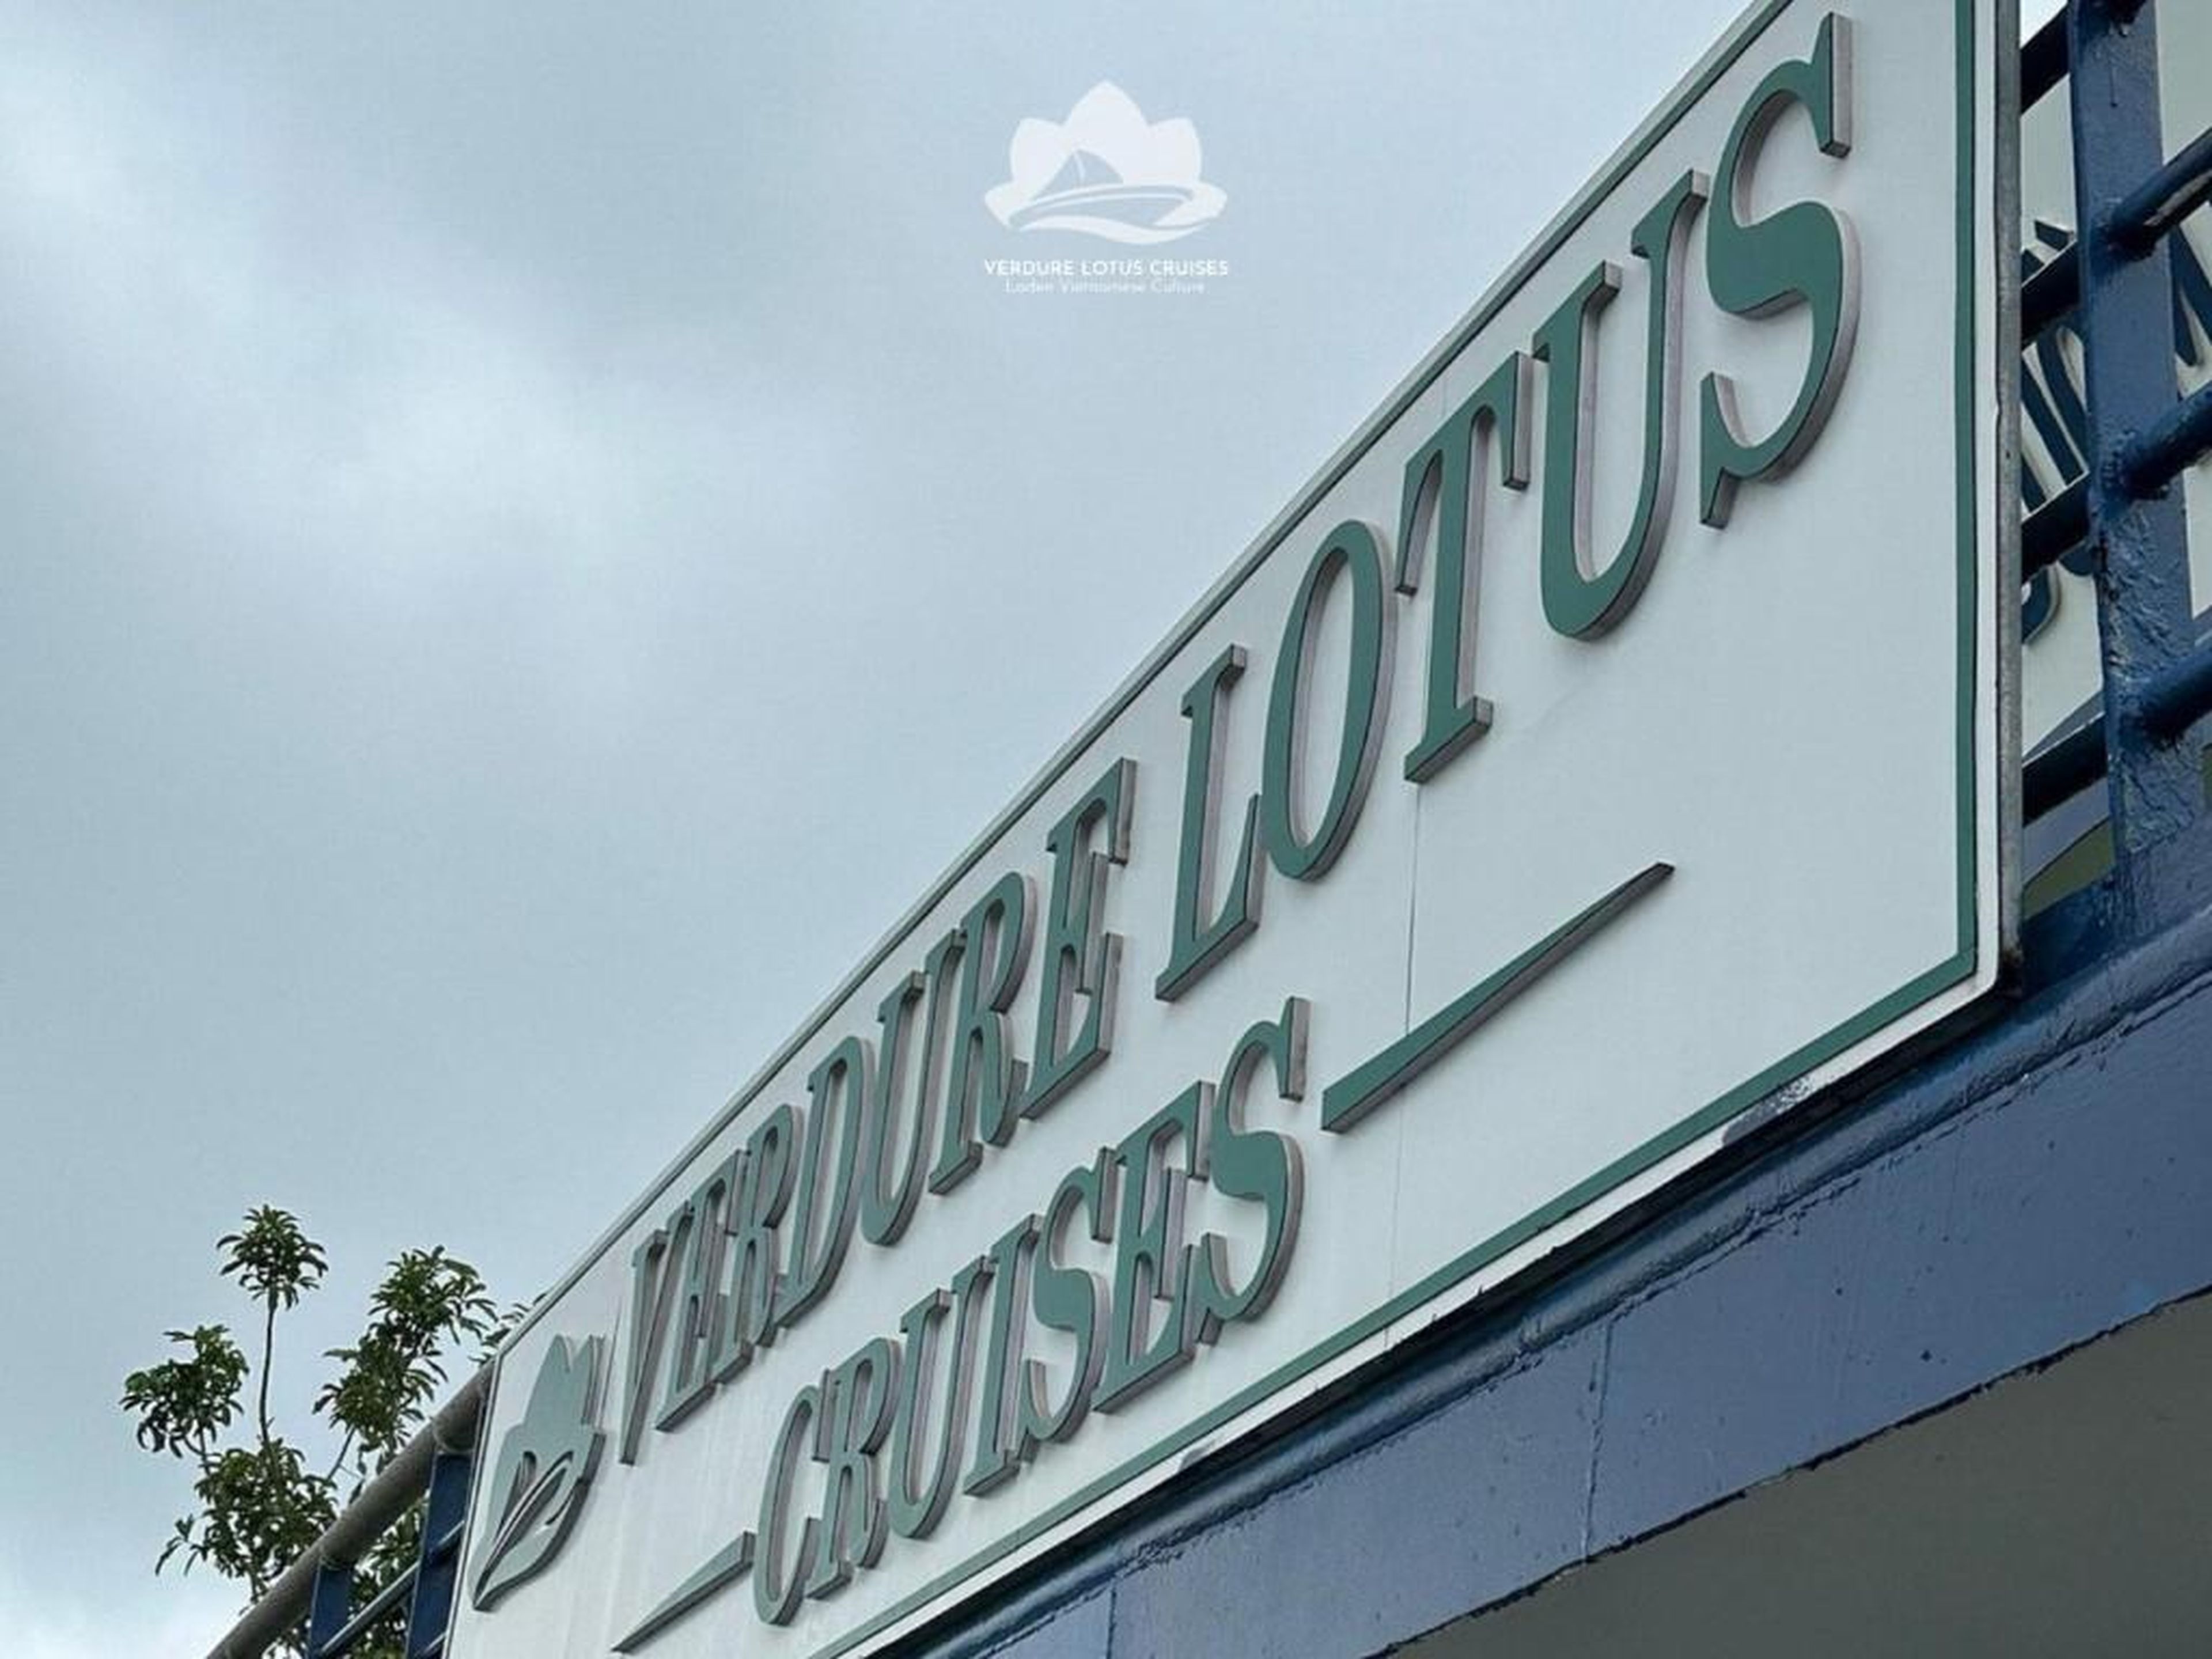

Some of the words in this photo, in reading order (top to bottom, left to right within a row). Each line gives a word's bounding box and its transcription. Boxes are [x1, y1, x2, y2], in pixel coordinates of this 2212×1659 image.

[619, 757, 1137, 1465] VERDURE
[1155, 12, 1859, 1003] LOTUS
[753, 997, 1310, 1626] CRUISES
